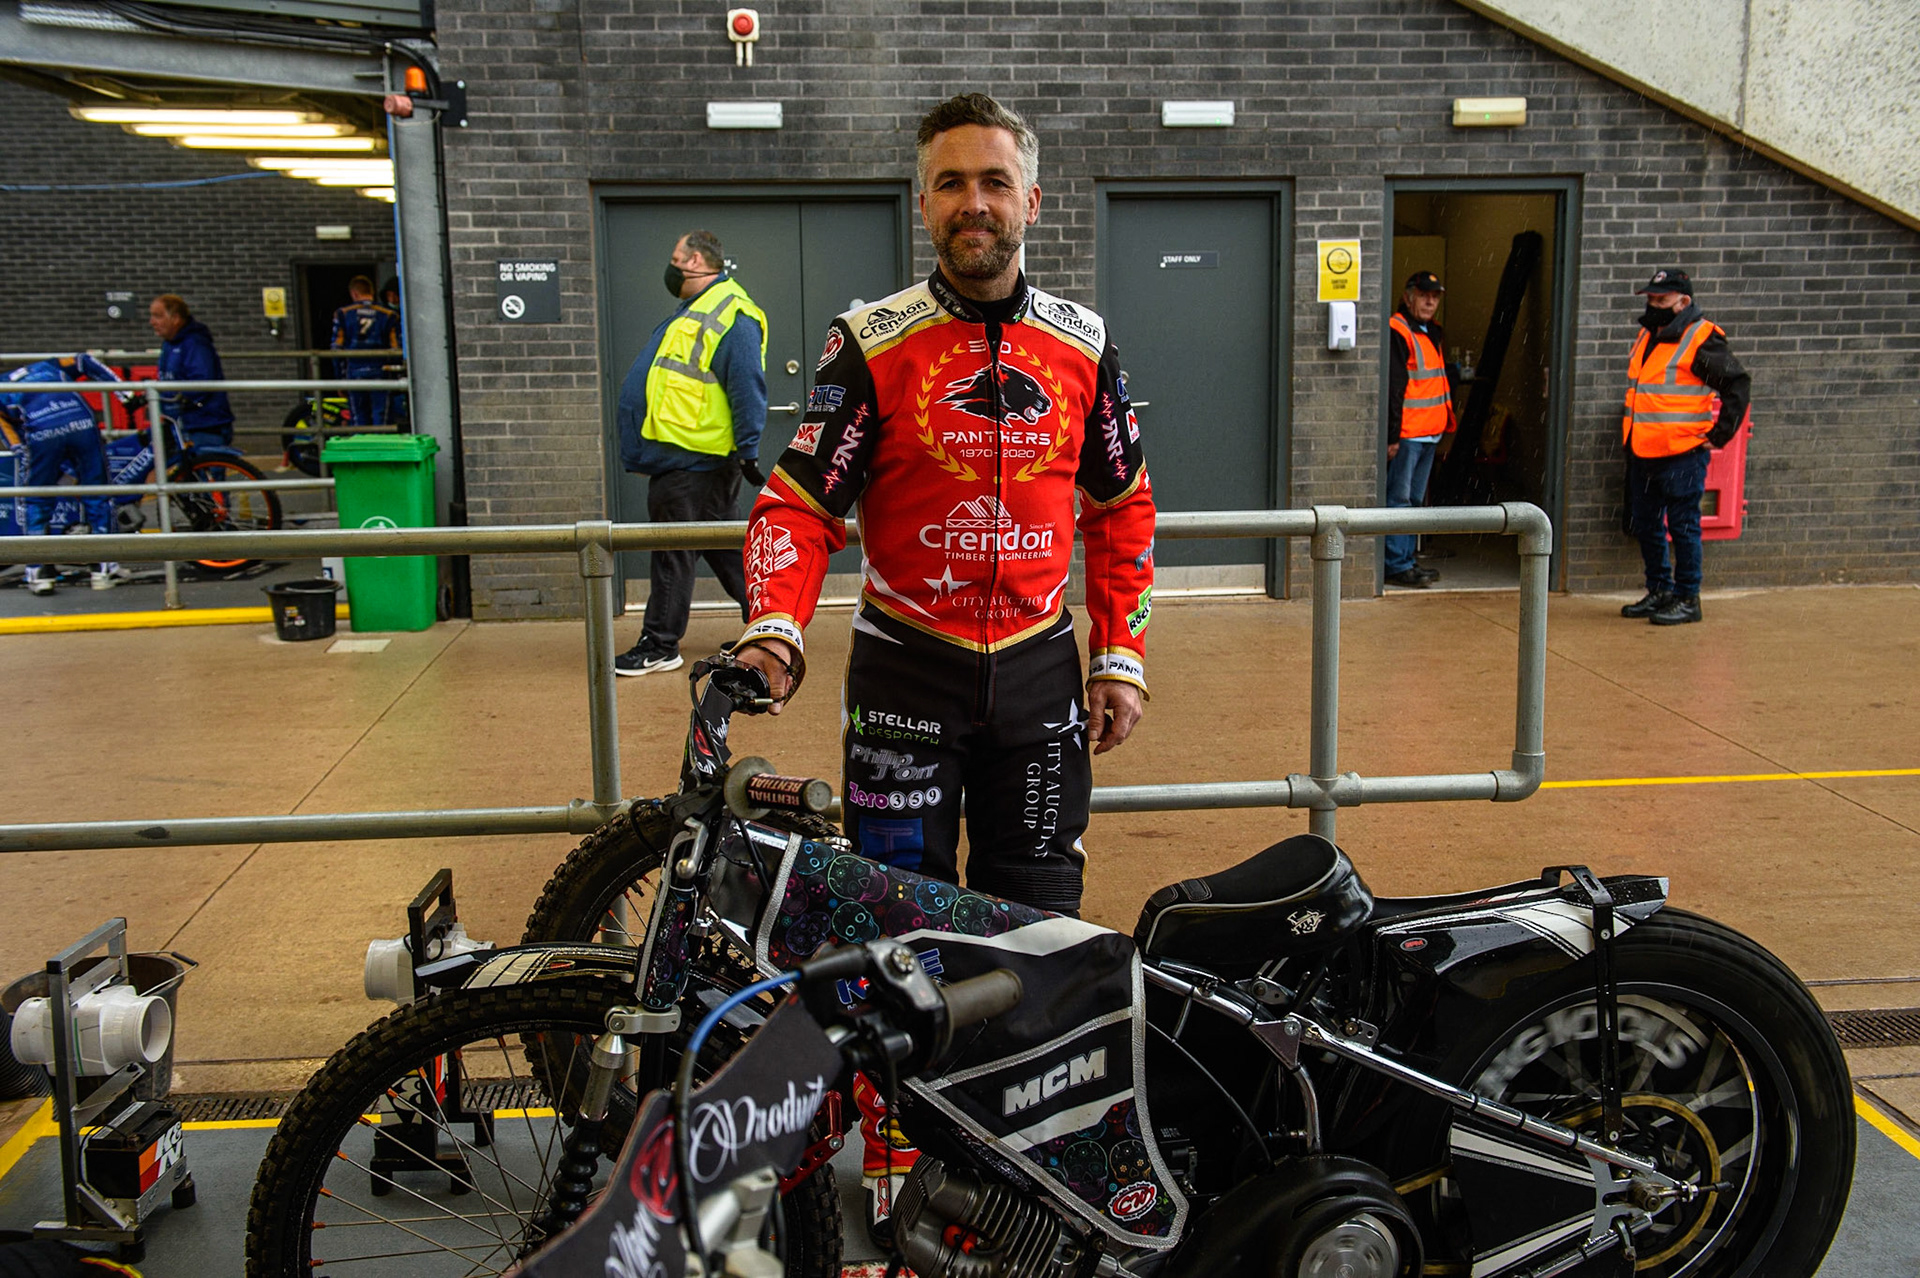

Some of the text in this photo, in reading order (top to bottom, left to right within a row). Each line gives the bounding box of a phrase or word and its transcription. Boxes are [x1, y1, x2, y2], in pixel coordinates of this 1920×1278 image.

[1163, 254, 1201, 263] STAFF ONLY
[499, 263, 556, 272] NO SMOKING
[500, 272, 548, 281] OR VAPING
[859, 300, 928, 339] Crendon
[1037, 301, 1101, 340] Crendon
[69, 418, 94, 430] FLUX
[942, 431, 1051, 446] PANTHERS
[959, 448, 1036, 459] 1970-2020
[918, 523, 1053, 552] Crendon
[944, 550, 1053, 562] TIMBER ENGINEERING
[952, 595, 984, 608] CITY
[974, 607, 1021, 620] GROUP
[868, 710, 942, 735] STELLAR
[868, 726, 941, 745] DESPATCH
[1047, 742, 1061, 775] ITY
[1023, 762, 1042, 830] GROUP
[1003, 1047, 1107, 1117] MCM
